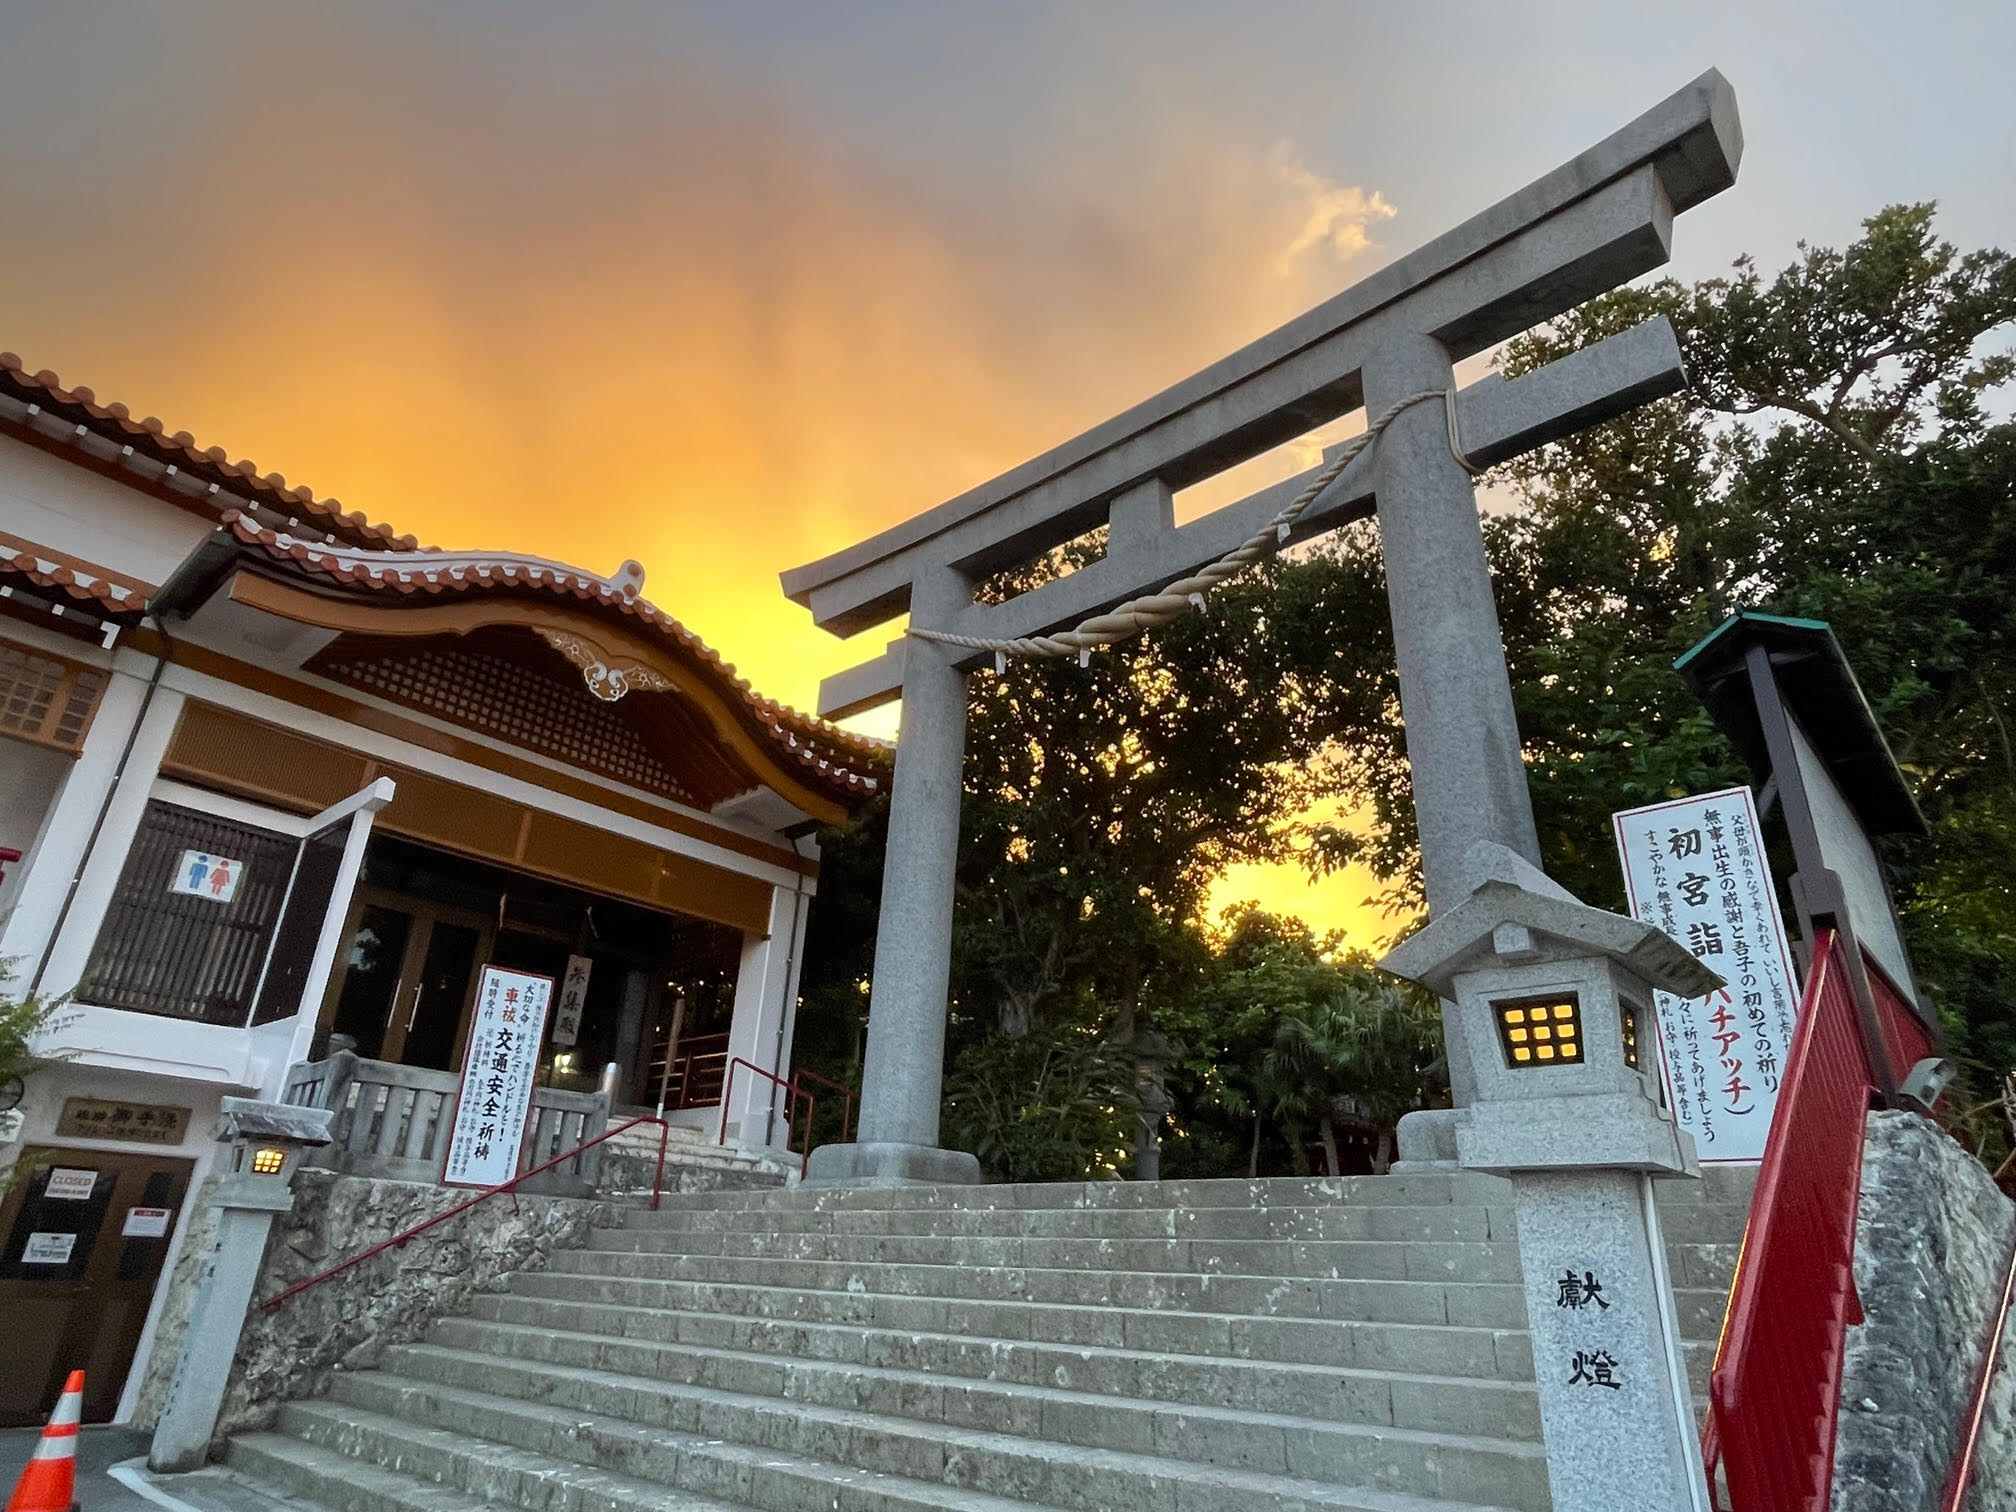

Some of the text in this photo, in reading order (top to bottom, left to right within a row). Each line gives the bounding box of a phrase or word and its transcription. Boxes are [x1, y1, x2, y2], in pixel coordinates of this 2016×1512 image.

[1667, 827, 1755, 1115] 初宮詣 ハチアッチ）
[1703, 808, 1779, 1094] 無事出生の感謝と吾子の初めての祈り
[1679, 997, 1715, 1143] 々に祈ってあげましょう
[52, 1175, 92, 1187] CLOSED
